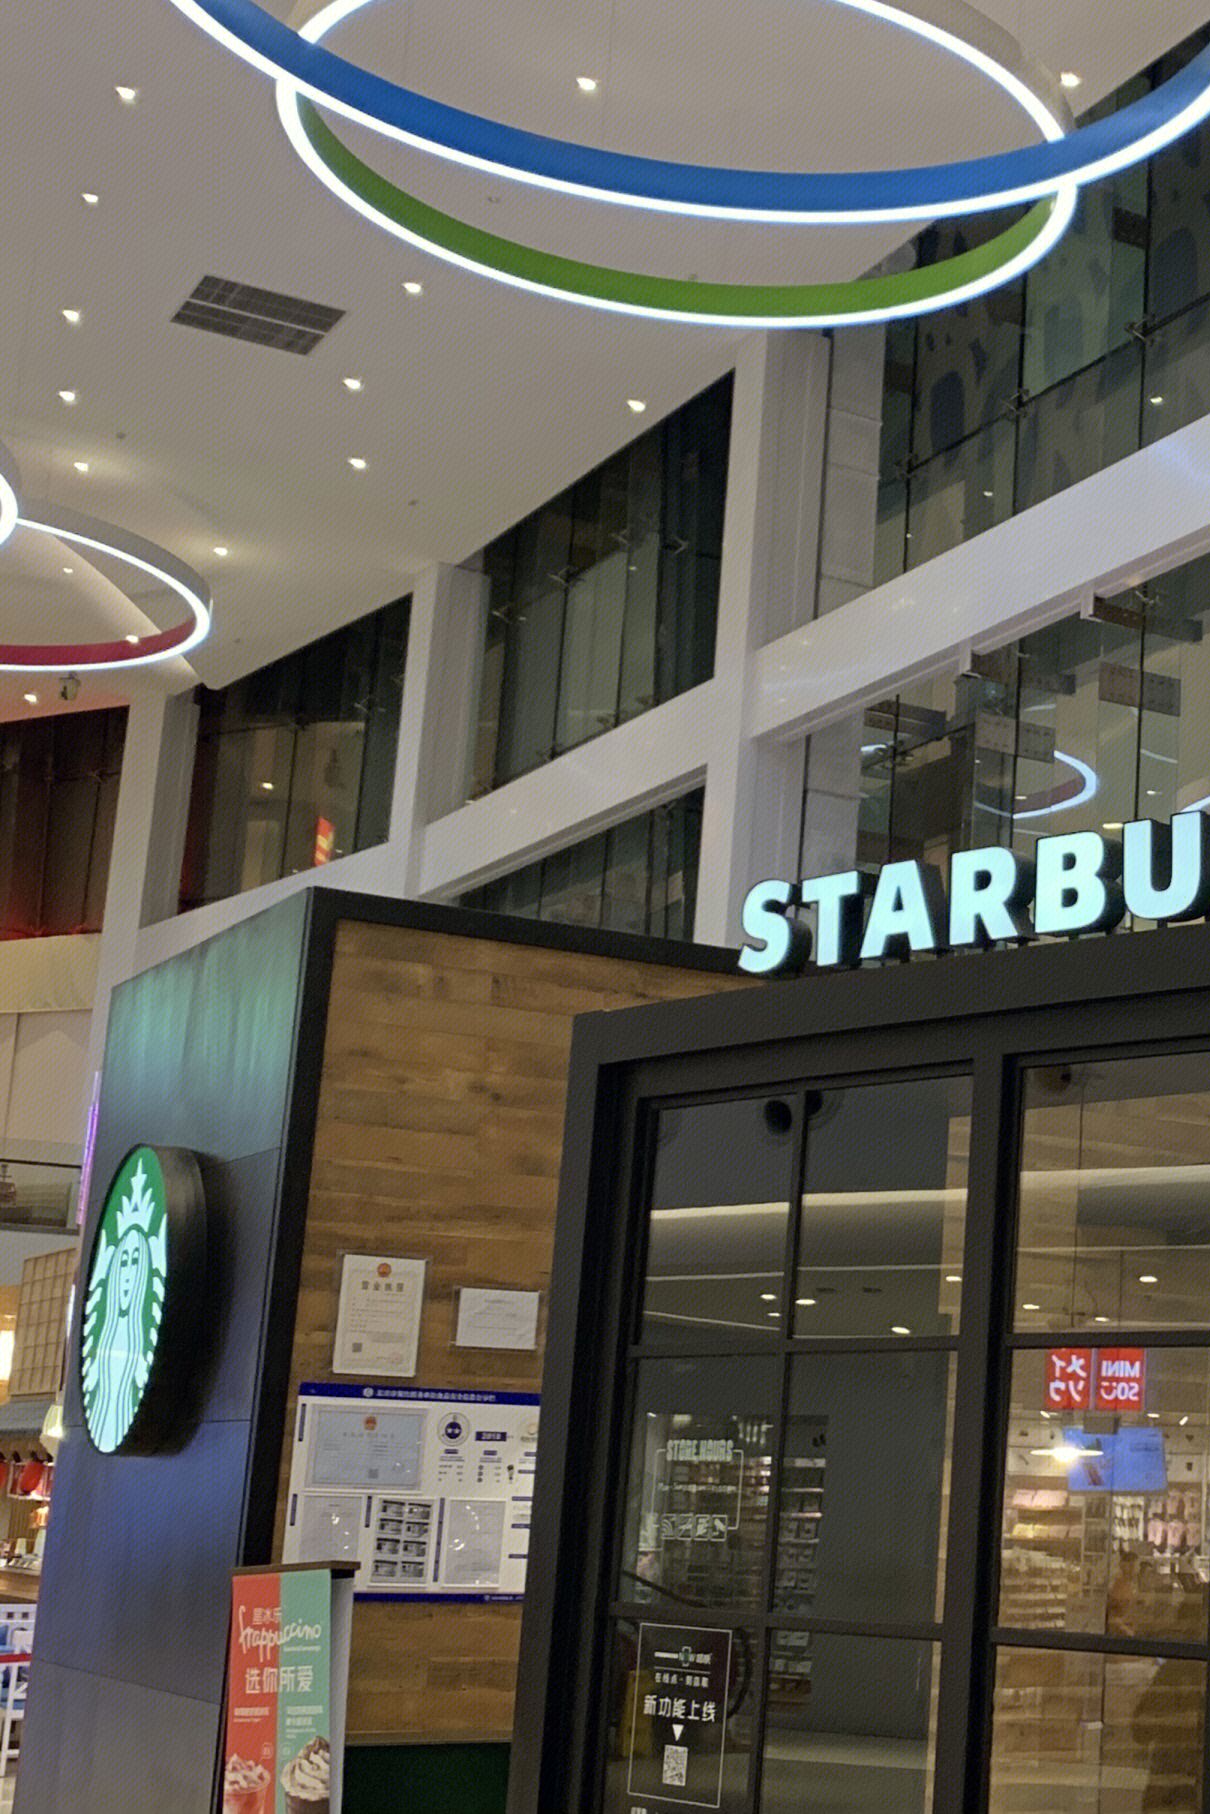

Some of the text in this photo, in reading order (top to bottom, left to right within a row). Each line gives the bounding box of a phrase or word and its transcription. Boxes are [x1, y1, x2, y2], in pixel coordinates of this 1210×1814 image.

[245, 1665, 313, 1694] 选你所爱
[643, 1694, 716, 1722] 新功能上线
